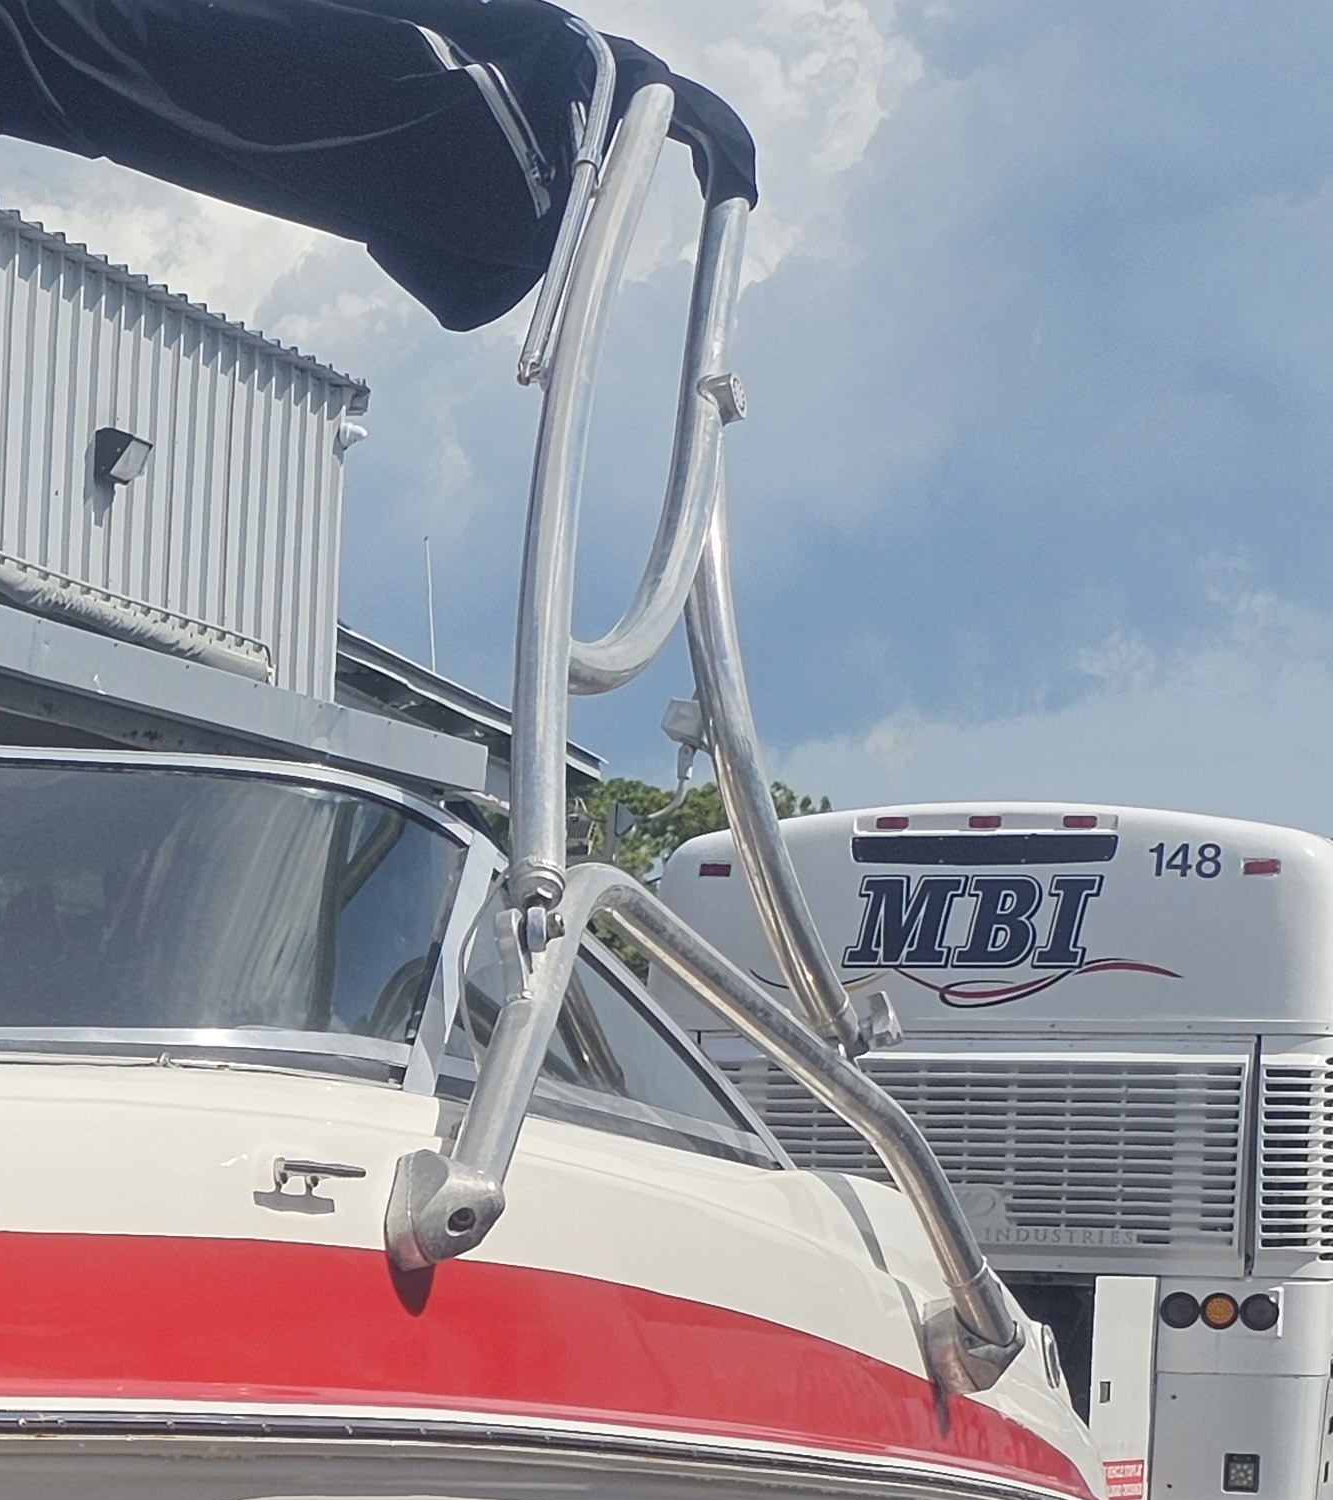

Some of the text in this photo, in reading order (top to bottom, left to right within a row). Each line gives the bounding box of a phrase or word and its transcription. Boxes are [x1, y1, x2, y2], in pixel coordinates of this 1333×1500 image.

[1148, 842, 1223, 879] 148
[841, 874, 1103, 968] MBI
[984, 1227, 1134, 1246] INDUSTRIES
